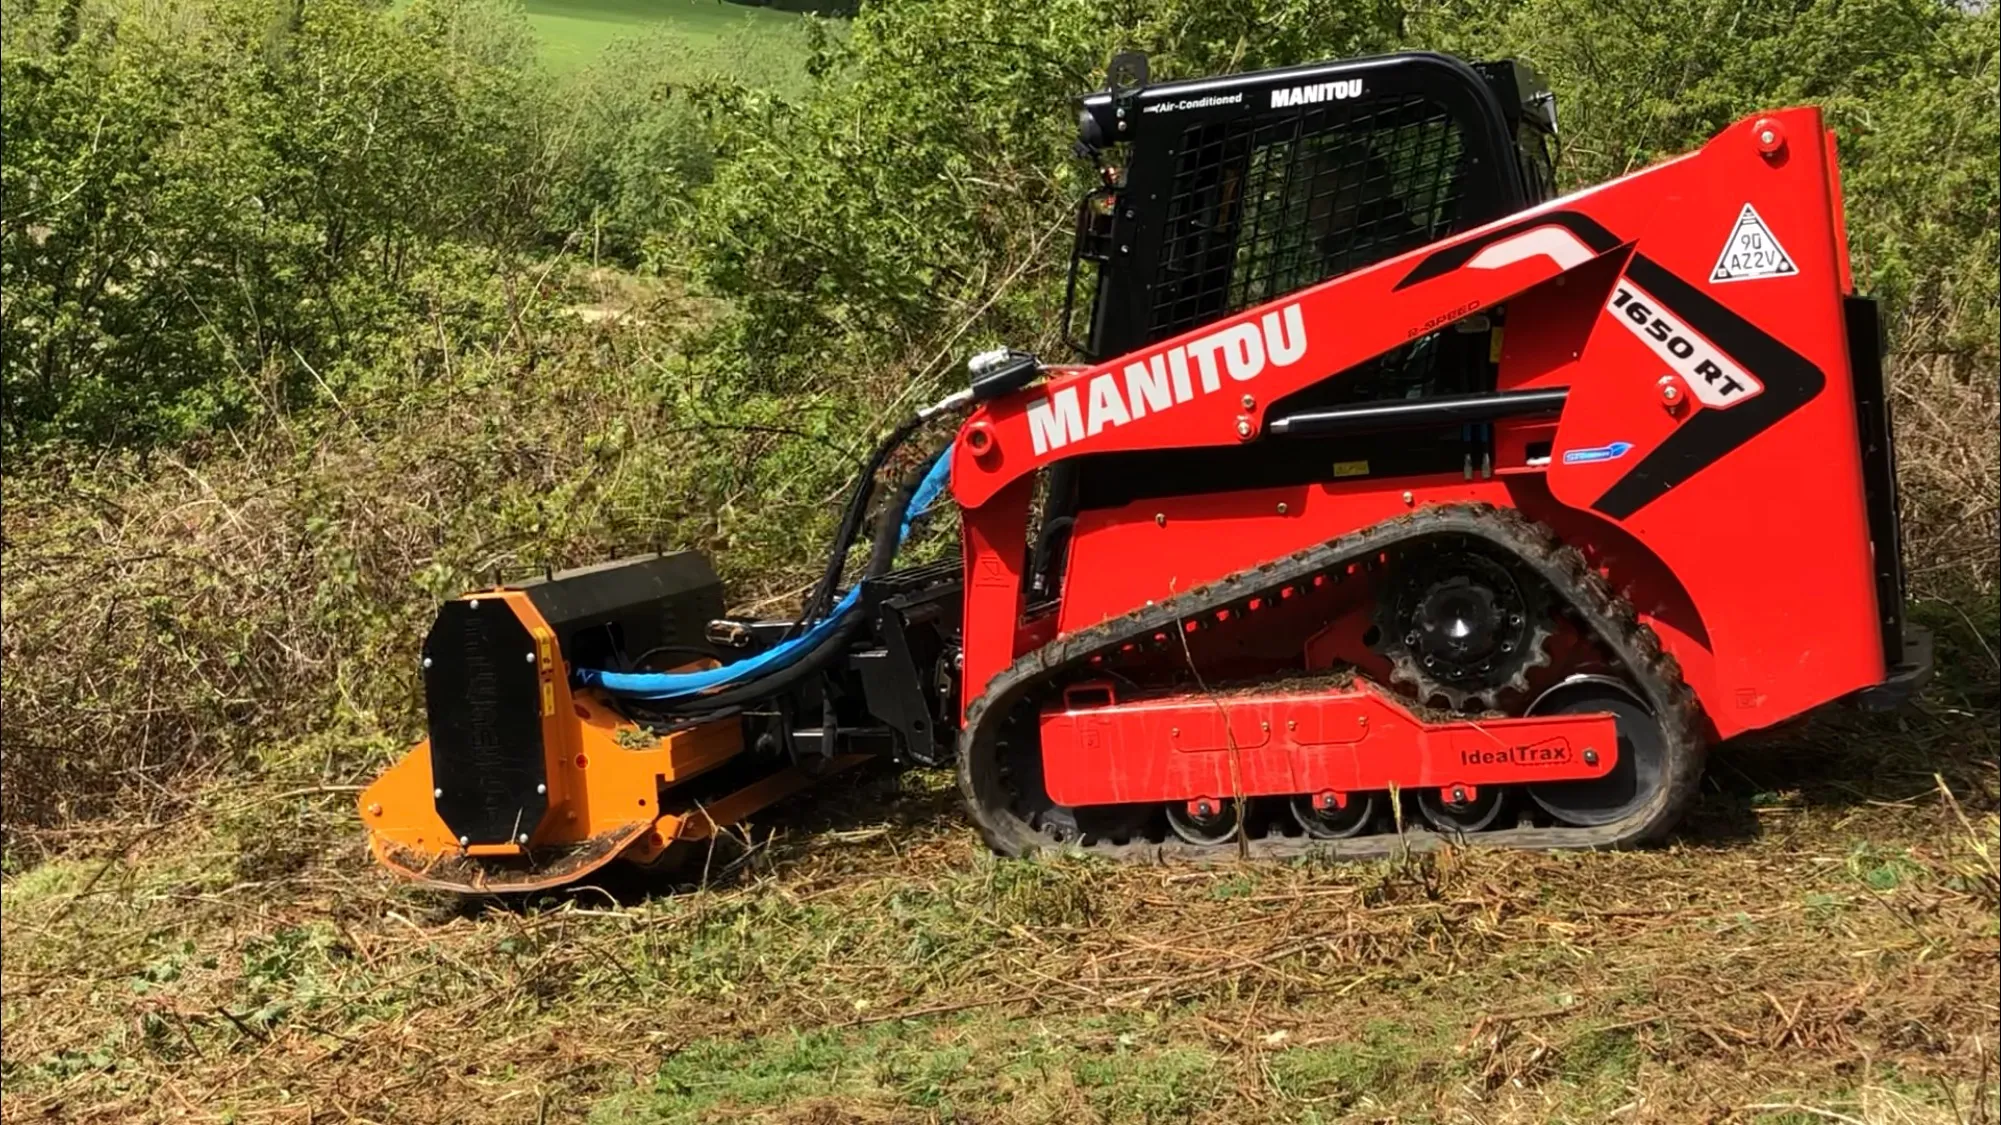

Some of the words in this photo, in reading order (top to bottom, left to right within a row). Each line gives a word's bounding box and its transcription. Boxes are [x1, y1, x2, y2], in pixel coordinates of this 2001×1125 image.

[1159, 93, 1242, 113] Air-Conditioned
[1271, 79, 1363, 108] MANITOU
[1731, 250, 1776, 270] AZ2V
[1613, 288, 1694, 359] 1650
[1694, 359, 1745, 396] RT
[1026, 303, 1308, 456] MANITOU
